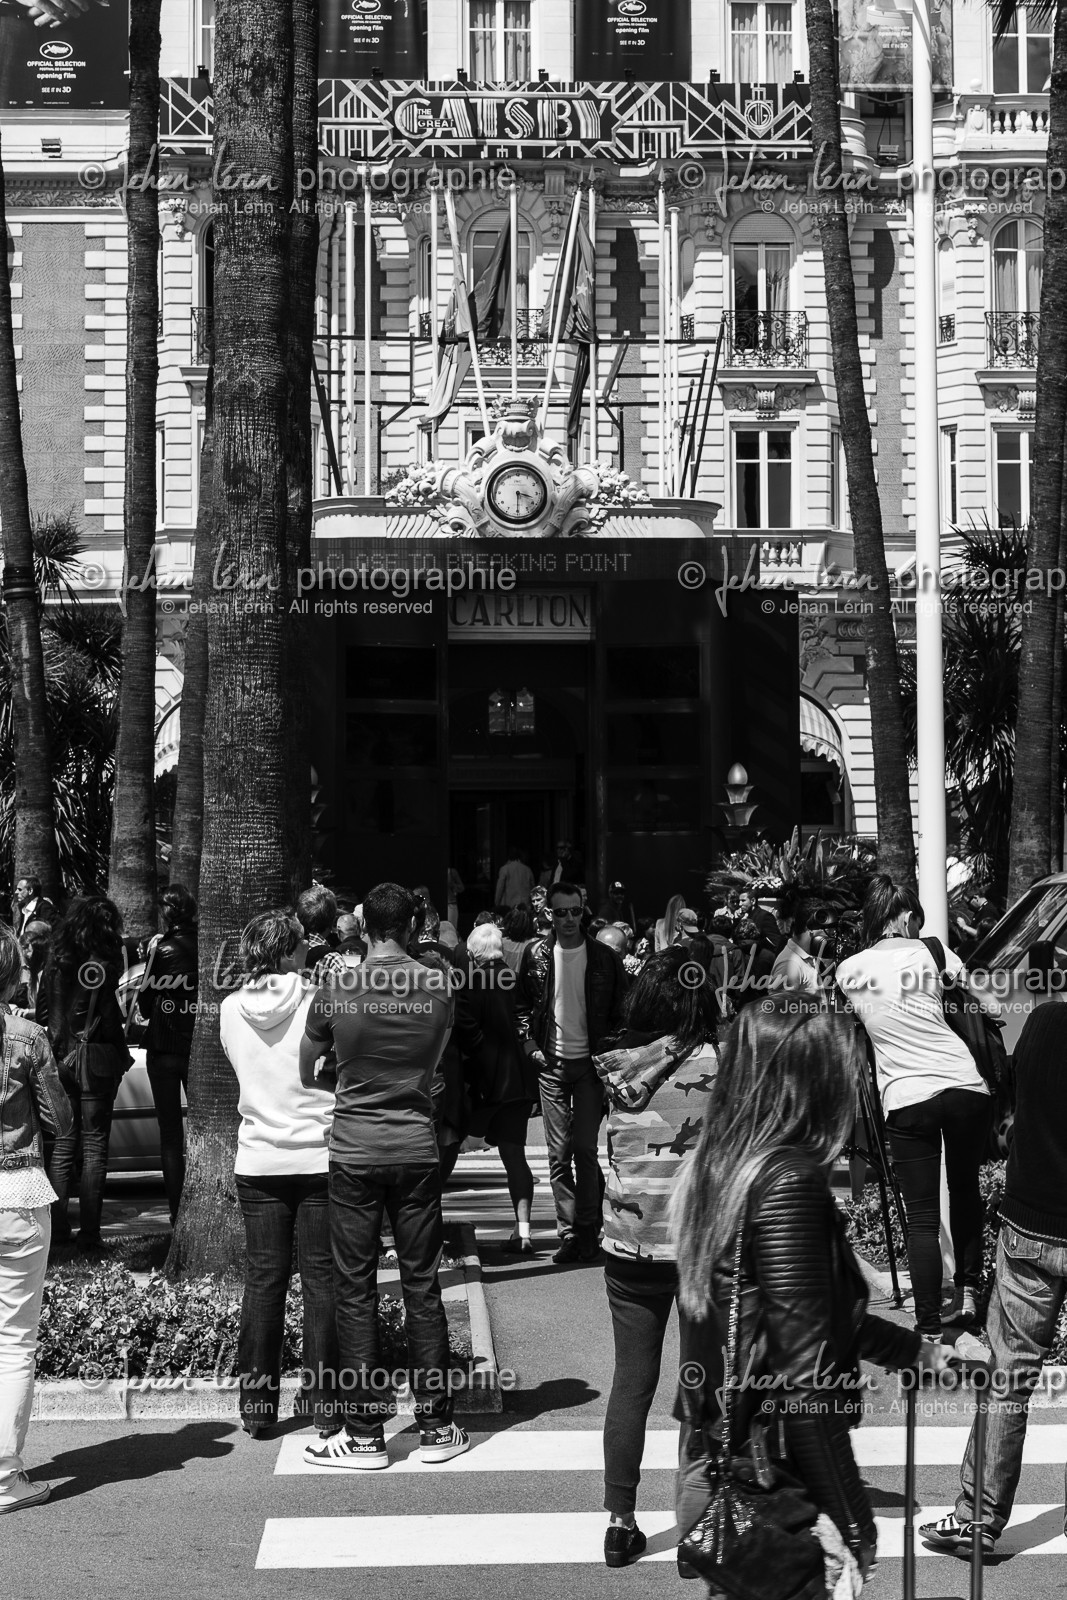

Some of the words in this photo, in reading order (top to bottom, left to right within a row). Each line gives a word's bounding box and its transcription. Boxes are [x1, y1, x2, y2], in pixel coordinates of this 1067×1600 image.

[394, 98, 608, 139] GATSBY
[418, 119, 454, 128] GREAT
[408, 553, 435, 572] TO
[446, 553, 557, 572] BREAKING
[565, 553, 632, 572] POINT
[450, 594, 588, 627] CARLTON
